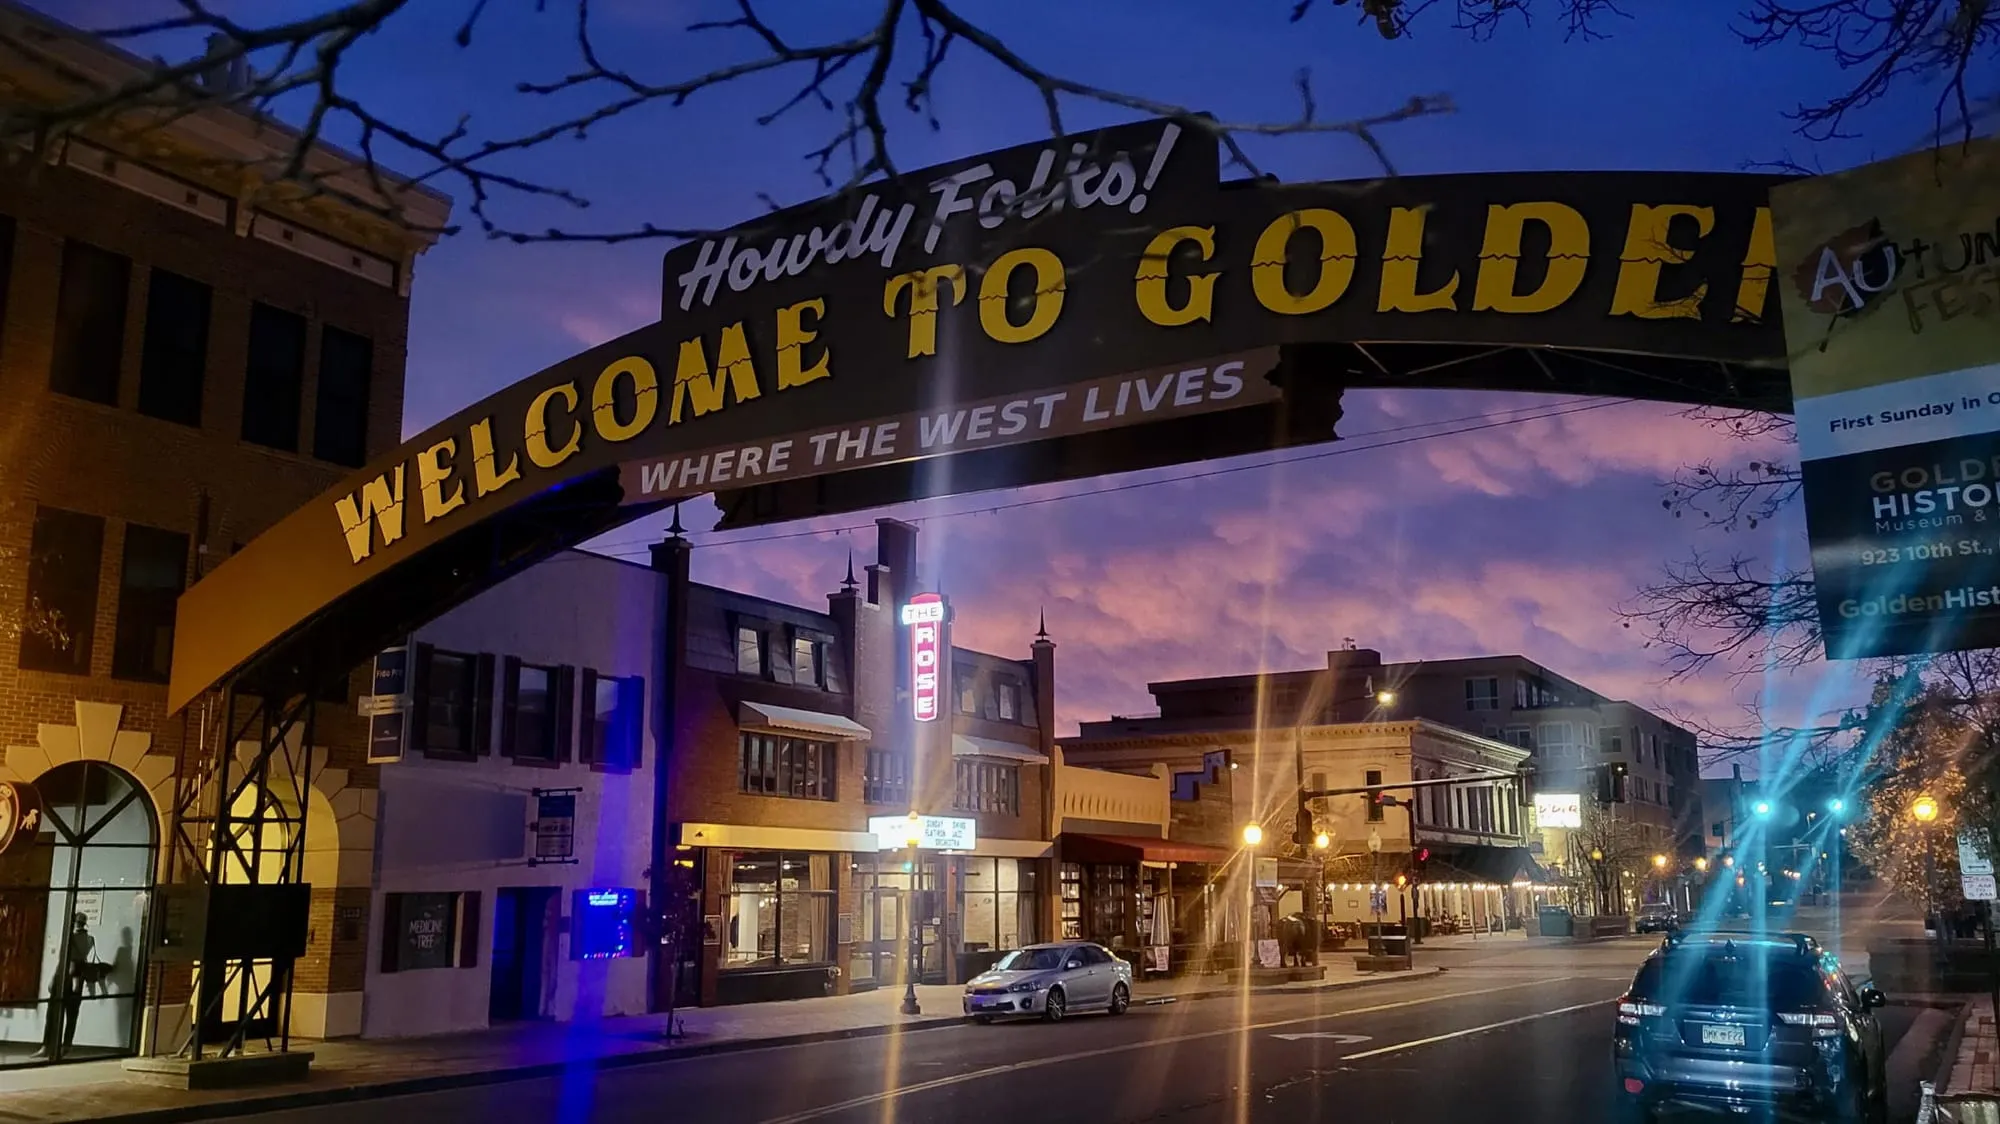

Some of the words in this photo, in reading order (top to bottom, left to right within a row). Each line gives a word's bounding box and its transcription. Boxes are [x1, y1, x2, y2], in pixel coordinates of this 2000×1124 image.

[678, 193, 915, 312] Howdy
[923, 122, 1182, 254] Folks!
[334, 297, 832, 565] WELCOME
[884, 248, 1067, 359] TO
[1829, 414, 1874, 433] First
[1880, 402, 1954, 424] Sunday
[1961, 397, 1981, 410] in
[641, 440, 793, 494] WHERE
[809, 421, 900, 466] THE
[918, 392, 1067, 450] WEST
[1082, 360, 1244, 422] LIVES
[1872, 483, 2000, 519] HISTO
[1875, 514, 1963, 534] Museum
[1973, 509, 1987, 523] &
[1861, 547, 1900, 565] 923
[1905, 542, 1953, 561] 10th
[907, 606, 939, 619] THE
[1838, 586, 2000, 618] GoldenHist
[916, 626, 935, 714] ROSE
